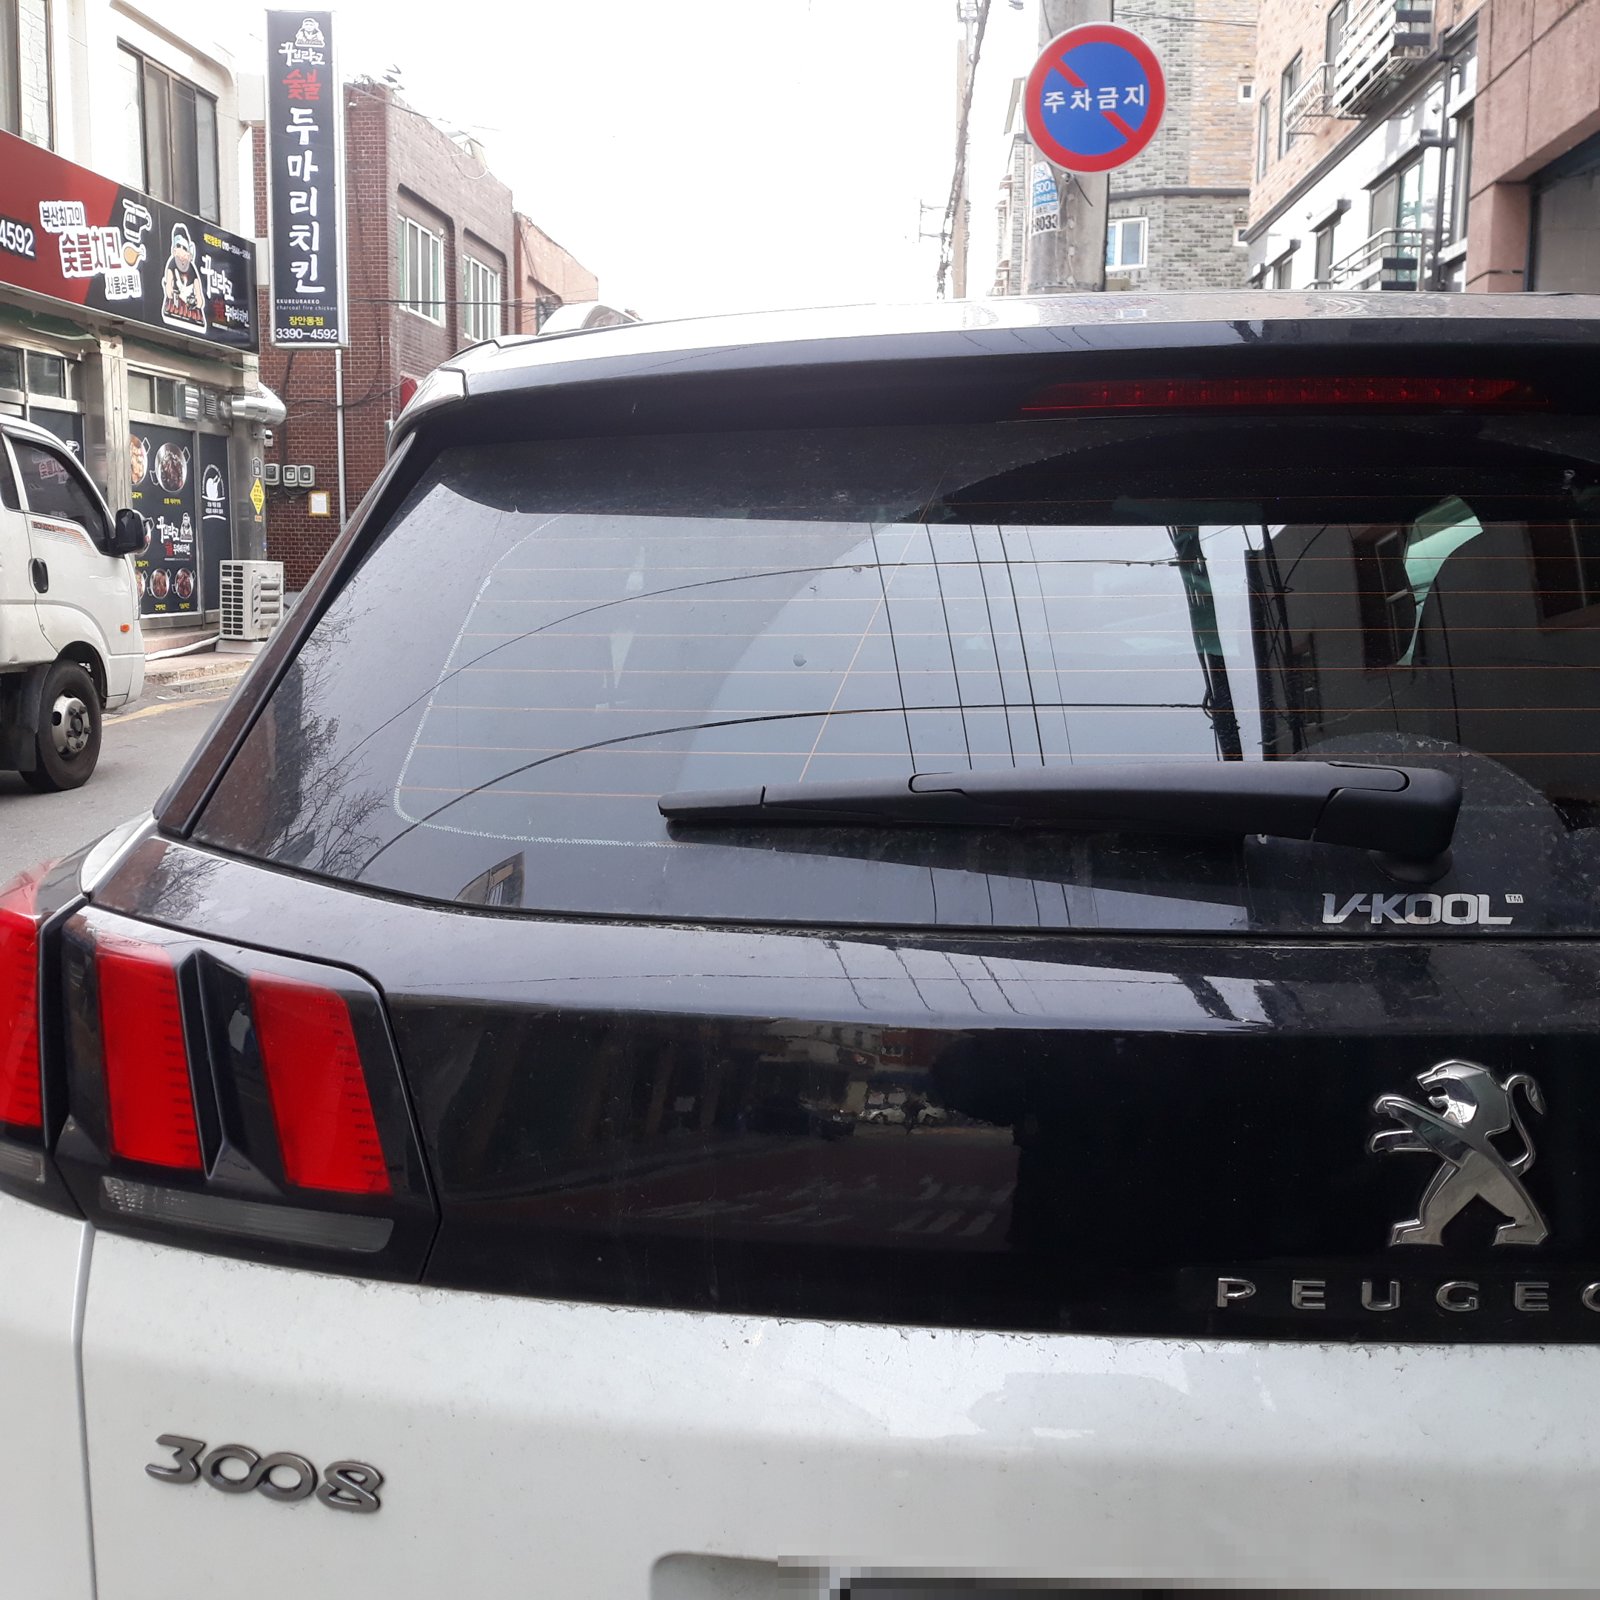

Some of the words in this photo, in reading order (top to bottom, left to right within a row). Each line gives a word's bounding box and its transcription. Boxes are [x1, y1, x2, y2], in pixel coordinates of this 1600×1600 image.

[1043, 84, 1145, 114] 주차금지
[286, 107, 326, 294] 두마리치킨
[0, 219, 35, 257] 4592
[62, 231, 122, 273] 숯불치킨
[276, 327, 338, 340] 3390-4592
[1322, 893, 1513, 925] V-KOOL
[145, 1434, 385, 1514] 3008
